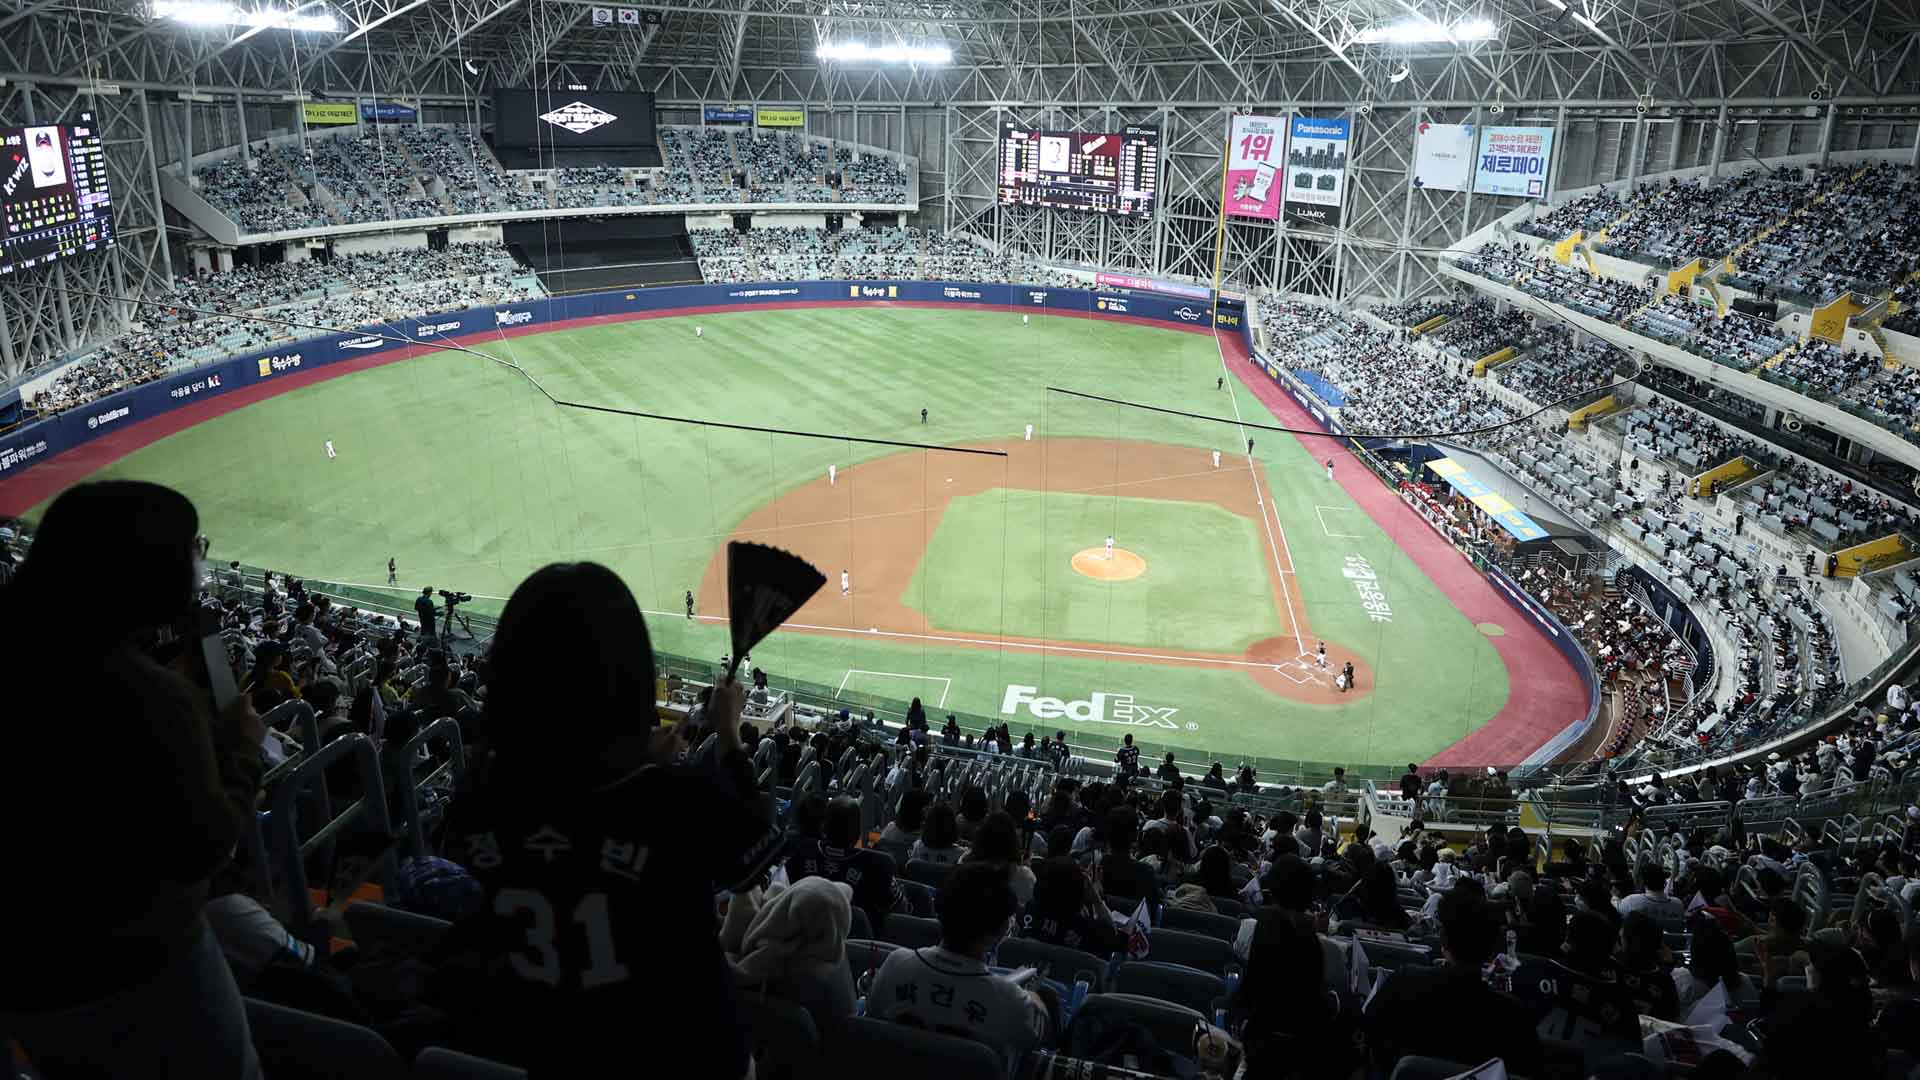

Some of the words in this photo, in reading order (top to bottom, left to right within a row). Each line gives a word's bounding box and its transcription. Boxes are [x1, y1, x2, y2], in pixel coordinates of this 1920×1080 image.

[1296, 123, 1343, 135] Panasonic
[1240, 134, 1274, 161] 1위
[1480, 154, 1545, 175] 제로페이
[3, 177, 17, 196] kt
[1296, 207, 1326, 218] LUMIX
[171, 385, 191, 399] 마음을
[191, 380, 205, 393] 담다
[207, 375, 222, 389] kt
[1001, 684, 1180, 729] FedEx
[491, 887, 631, 990] 31
